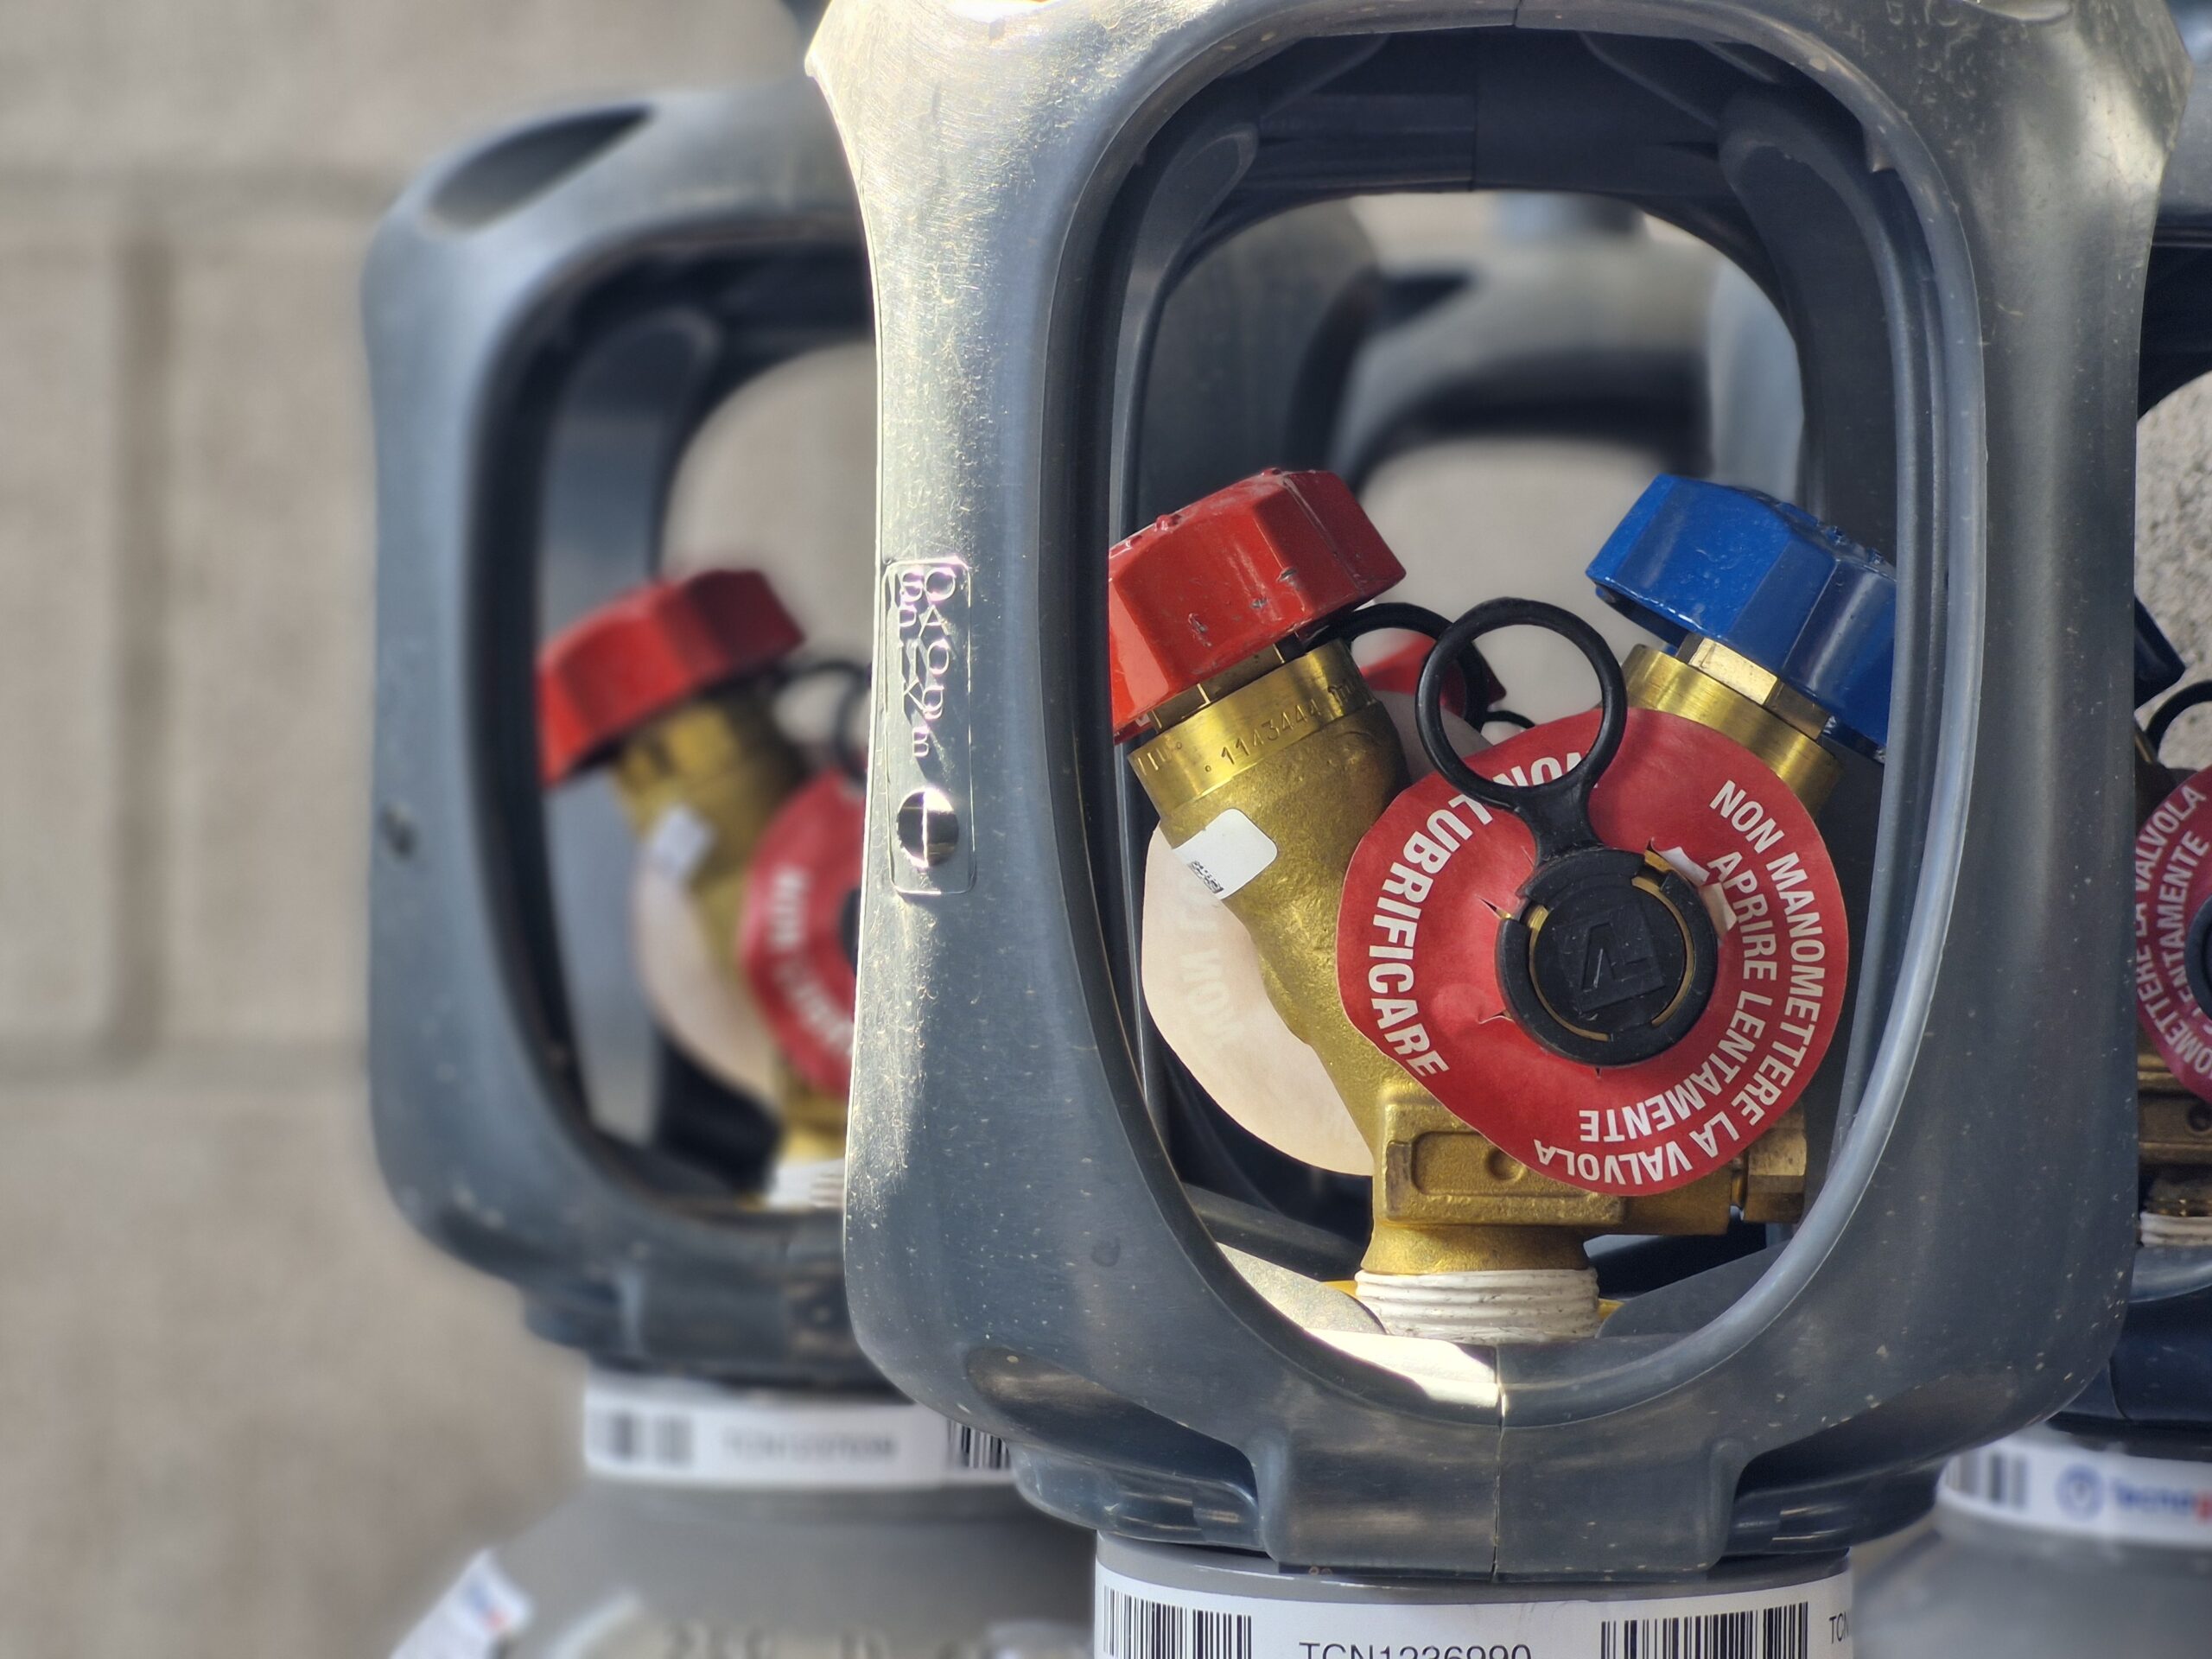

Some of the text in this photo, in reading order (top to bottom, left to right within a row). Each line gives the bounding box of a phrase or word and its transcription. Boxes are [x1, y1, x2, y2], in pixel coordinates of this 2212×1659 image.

[1368, 751, 1598, 1077] ON LUBRIFICARE
[1533, 779, 1826, 1185] NON MANOMETTERE LA VALVOLA
[2135, 785, 2207, 892] VALVOLA
[1578, 850, 1778, 1143] APRIRE LENTAMENTE
[2136, 944, 2212, 1078] OMETTERE
